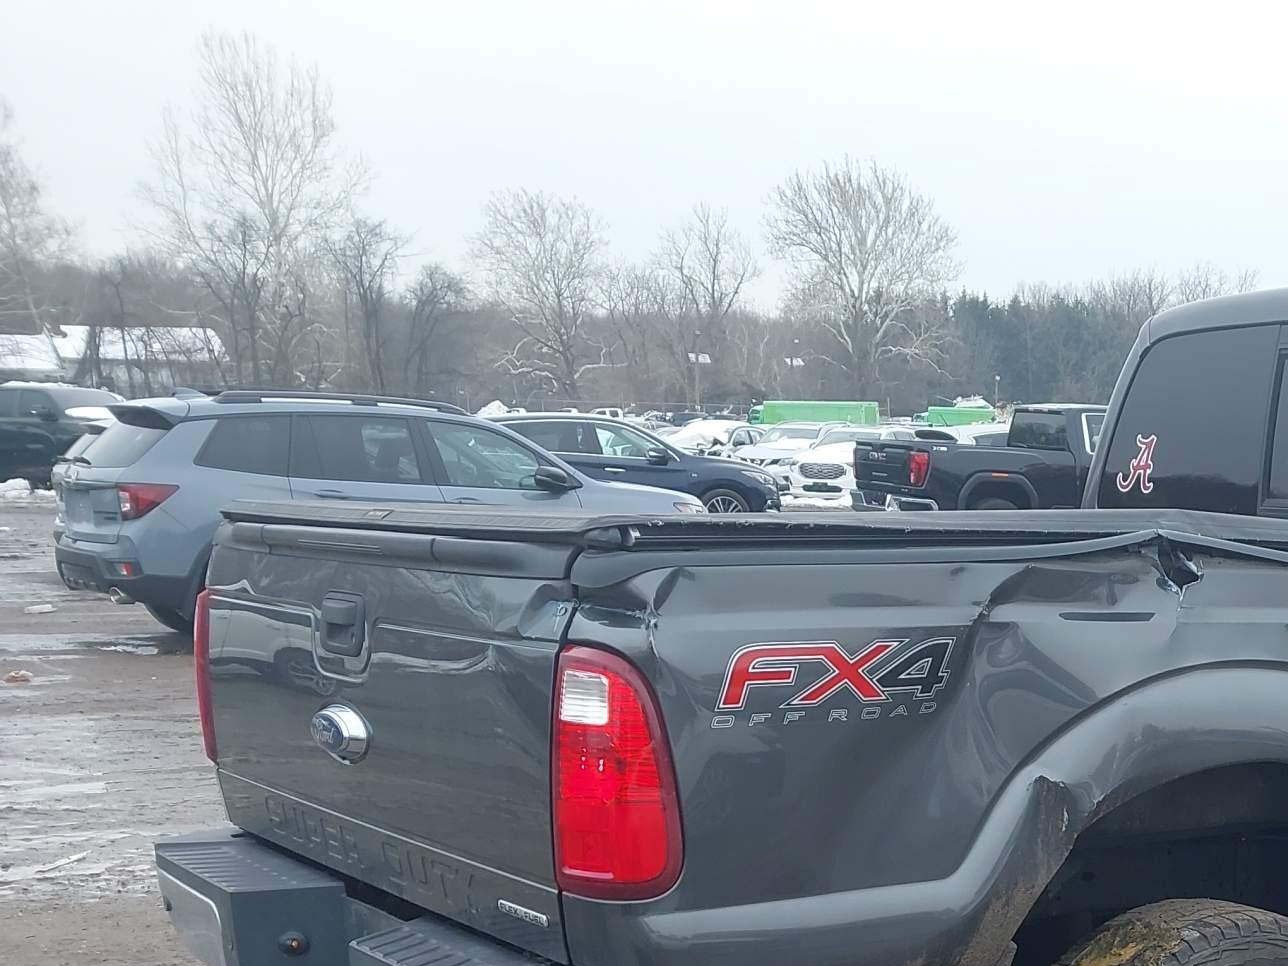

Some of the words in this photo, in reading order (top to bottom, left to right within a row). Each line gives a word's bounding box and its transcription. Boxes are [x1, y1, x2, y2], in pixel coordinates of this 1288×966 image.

[1116, 434, 1158, 494] A
[713, 637, 957, 712] FX4
[711, 712, 806, 729] OFF
[828, 702, 938, 723] ROAD
